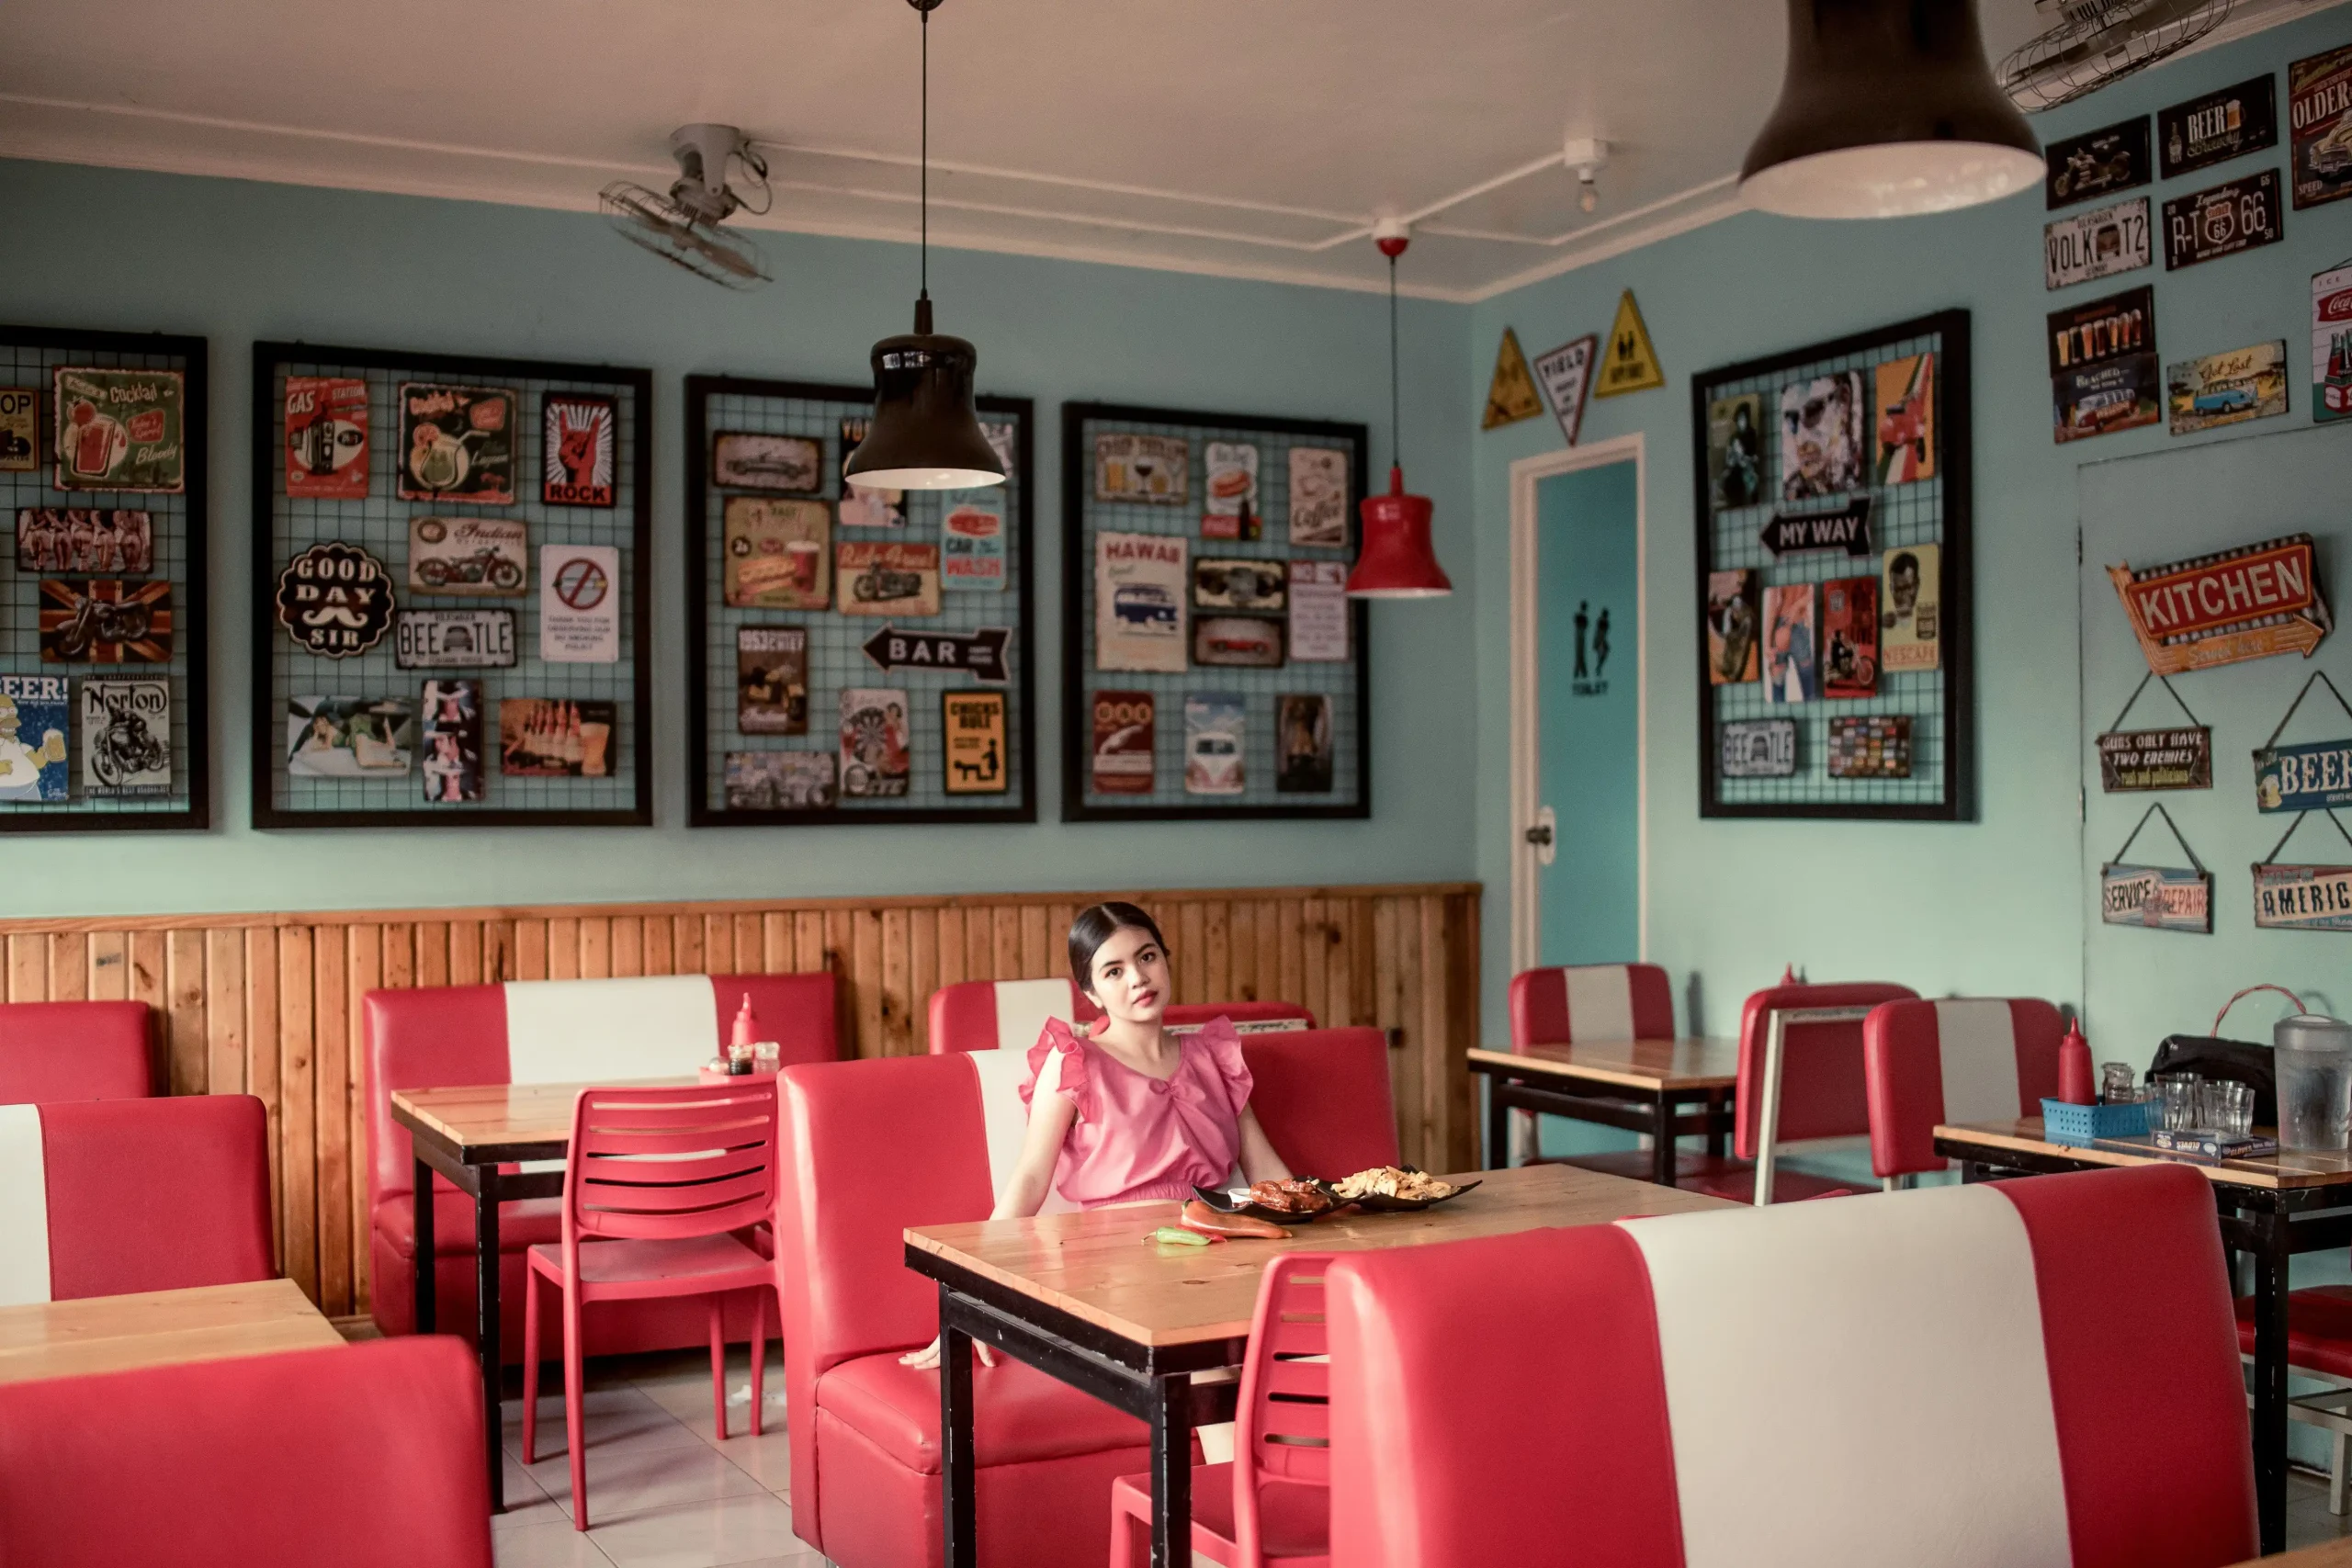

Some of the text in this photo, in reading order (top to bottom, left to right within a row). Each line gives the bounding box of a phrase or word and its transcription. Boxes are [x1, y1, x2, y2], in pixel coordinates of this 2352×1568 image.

[2293, 81, 2351, 129] OLDER
[2187, 105, 2226, 143] BEER
[2298, 180, 2323, 195] SPEED
[2240, 191, 2267, 235] 66
[2213, 222, 2226, 240] 66
[2049, 228, 2094, 274] VOLK
[2121, 214, 2145, 254] T2
[2327, 294, 2352, 315] Coca
[109, 381, 158, 403] Cocktail
[287, 389, 315, 414] GAS
[136, 442, 177, 465] Bloody
[550, 484, 606, 502] ROCK
[1779, 516, 1860, 547] MY WAY
[297, 558, 377, 582] GOOD
[295, 584, 376, 604] DAY
[2138, 556, 2306, 629] KITCHEN
[311, 628, 359, 647] SIR
[401, 622, 511, 655] BEE TLE
[888, 637, 956, 664] BAR
[0, 676, 69, 700] EER!
[85, 683, 167, 714] Norton
[2103, 731, 2203, 750] GUNS ONLY HAVE
[2113, 749, 2194, 766] TWO ENEMIES
[2104, 878, 2152, 913] SERVICE
[2263, 881, 2351, 918] AMERIC
